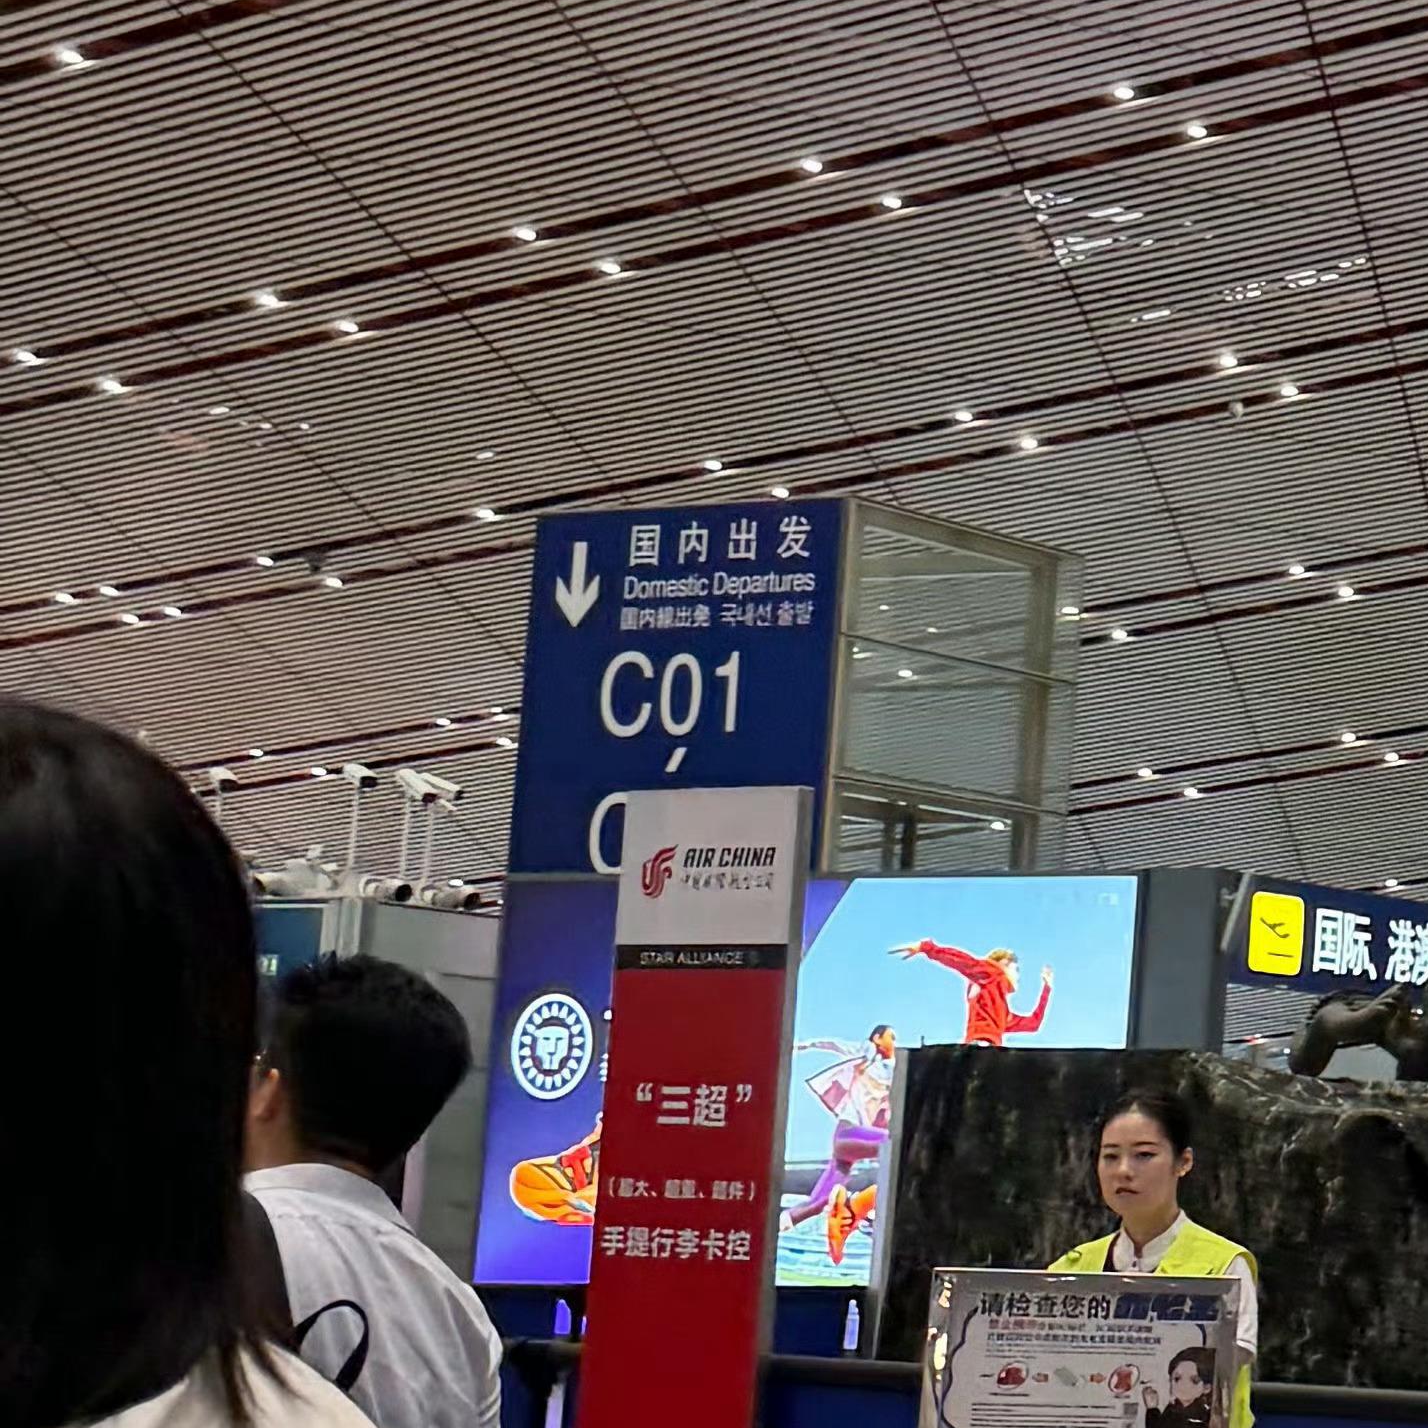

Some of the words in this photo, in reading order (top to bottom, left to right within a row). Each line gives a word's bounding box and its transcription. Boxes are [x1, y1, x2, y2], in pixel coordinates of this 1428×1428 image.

[628, 515, 812, 566] 国内出发
[623, 574, 709, 599] Domestic
[713, 571, 816, 599] Departures
[599, 650, 740, 738] C01
[683, 847, 716, 868] AIR
[718, 846, 777, 868] CHINA
[639, 952, 674, 965] STAR
[677, 951, 744, 965] ALLIANCE
[1312, 908, 1378, 981] 国际
[601, 1226, 751, 1260] 手提行李卡控
[979, 1291, 1112, 1321] 请检查您的
